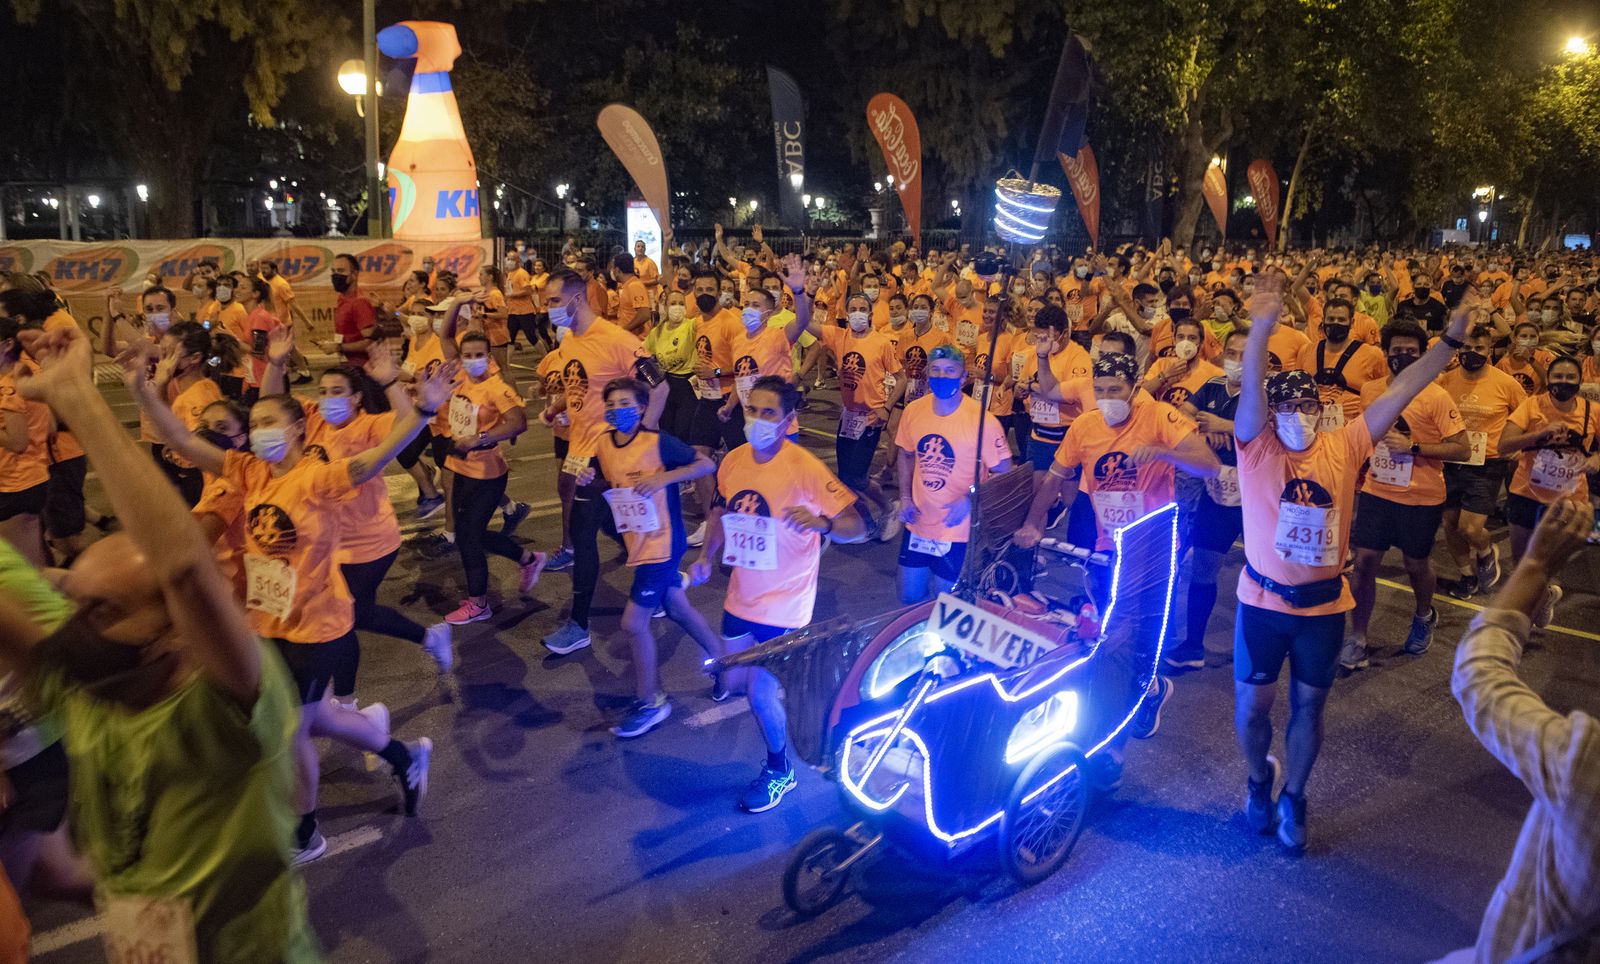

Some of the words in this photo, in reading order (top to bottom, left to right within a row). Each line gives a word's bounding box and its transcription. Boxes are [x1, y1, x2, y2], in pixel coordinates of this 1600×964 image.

[1374, 456, 1404, 471] 8391
[1542, 464, 1574, 480] 1298
[616, 502, 647, 516] 1218
[1103, 508, 1136, 523] 4320
[731, 532, 766, 551] 1218
[1286, 526, 1333, 545] 4319
